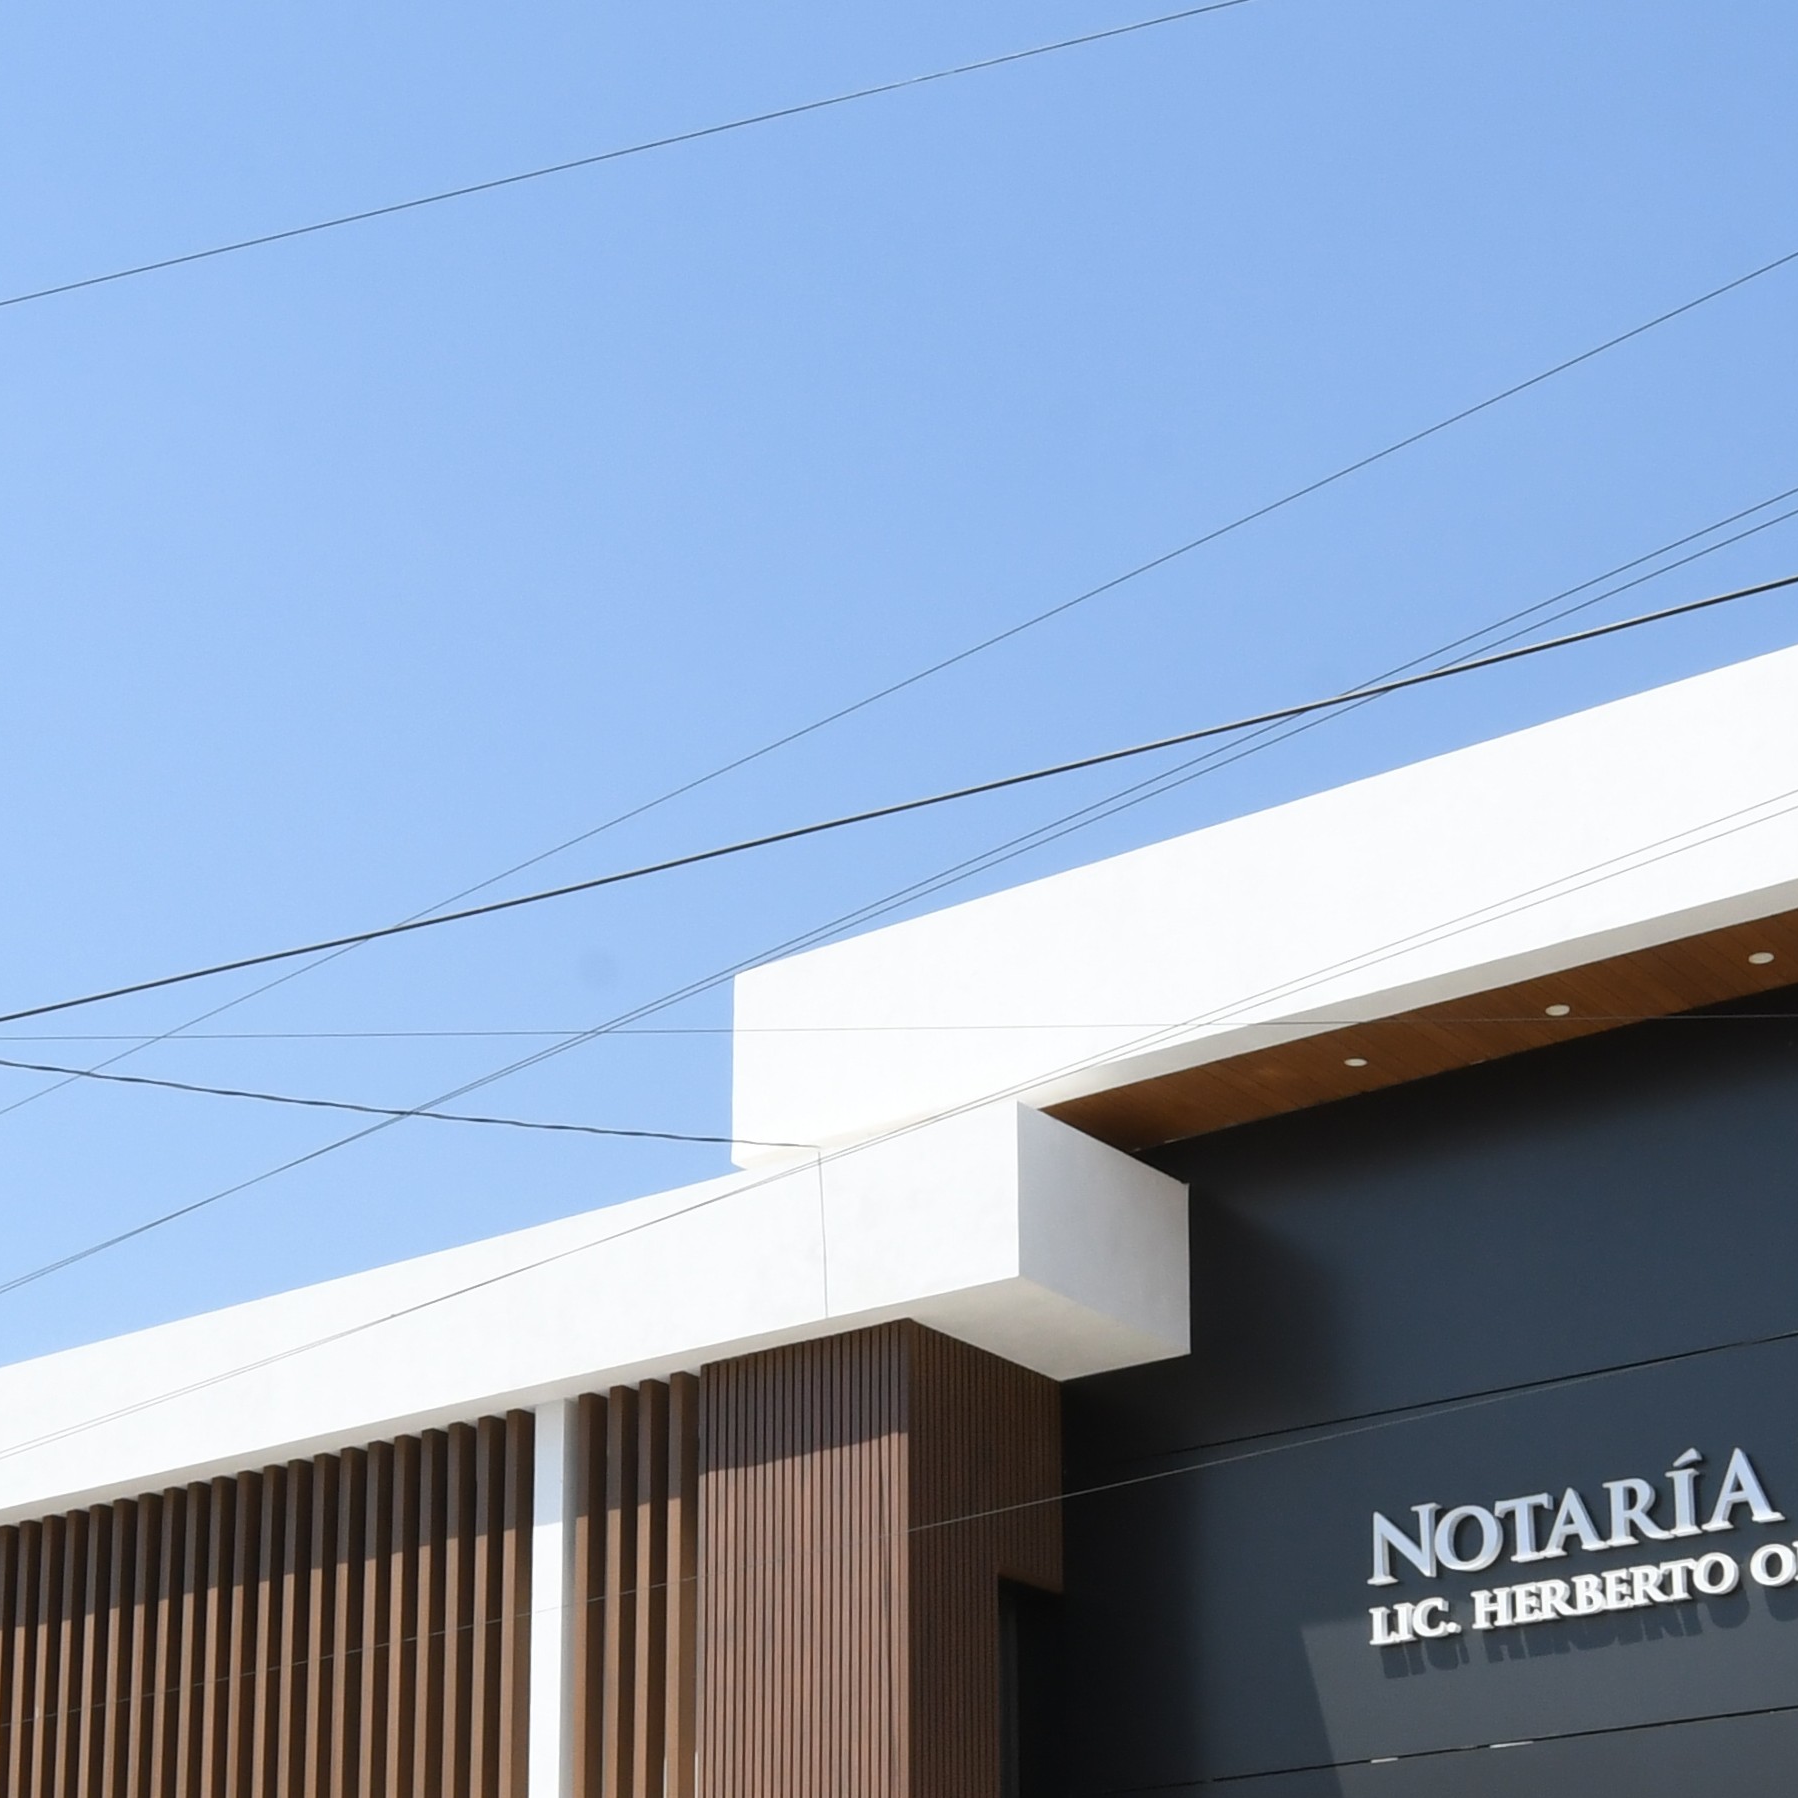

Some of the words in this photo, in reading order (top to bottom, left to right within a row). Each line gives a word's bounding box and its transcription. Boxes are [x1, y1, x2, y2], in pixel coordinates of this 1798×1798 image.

[1368, 1448, 1786, 1585] NOTARÍA
[1370, 1600, 1460, 1647] LIC.
[1471, 1550, 1739, 1630] HERBERTO
